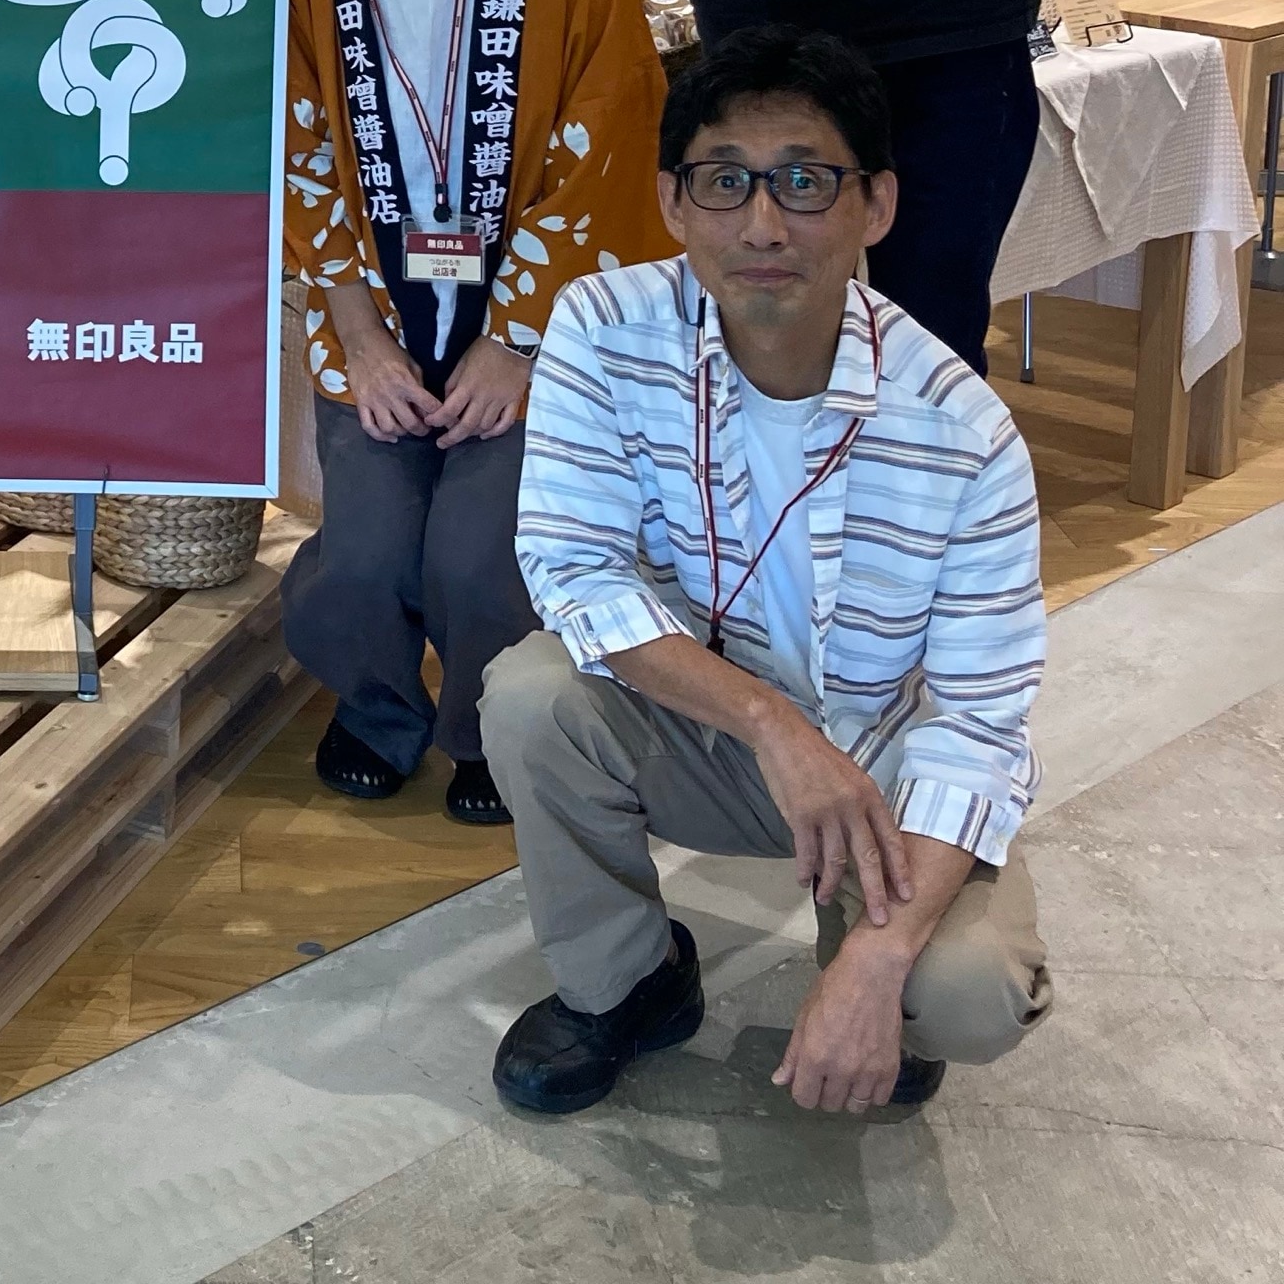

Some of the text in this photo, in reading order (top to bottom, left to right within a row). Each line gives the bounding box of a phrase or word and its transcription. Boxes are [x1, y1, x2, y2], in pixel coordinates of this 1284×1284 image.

[426, 238, 464, 251] 無印良品
[25, 318, 205, 366] 無印良品
